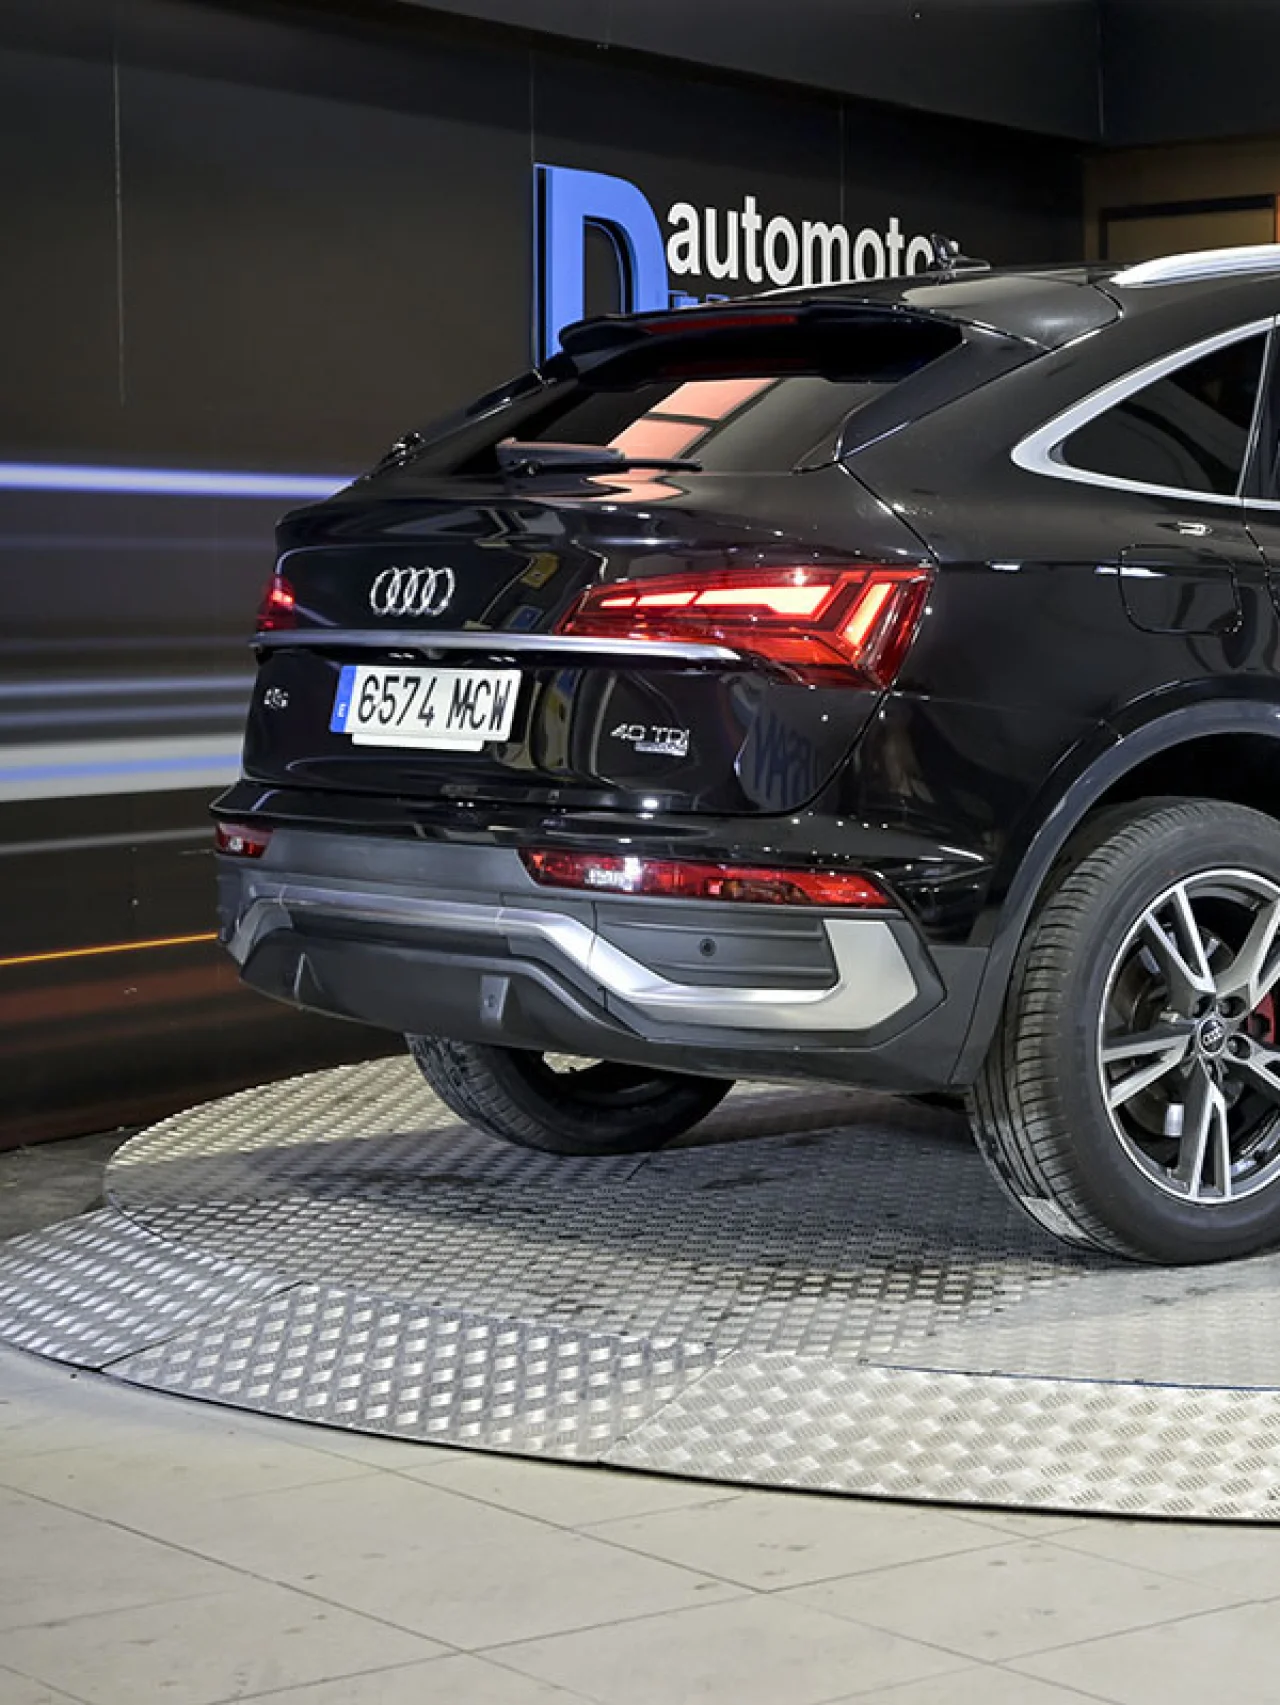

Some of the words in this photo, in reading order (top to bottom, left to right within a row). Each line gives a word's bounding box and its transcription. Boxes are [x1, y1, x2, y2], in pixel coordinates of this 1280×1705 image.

[357, 673, 438, 729] 6574
[445, 677, 513, 731] MCW
[610, 723, 645, 741] 40
